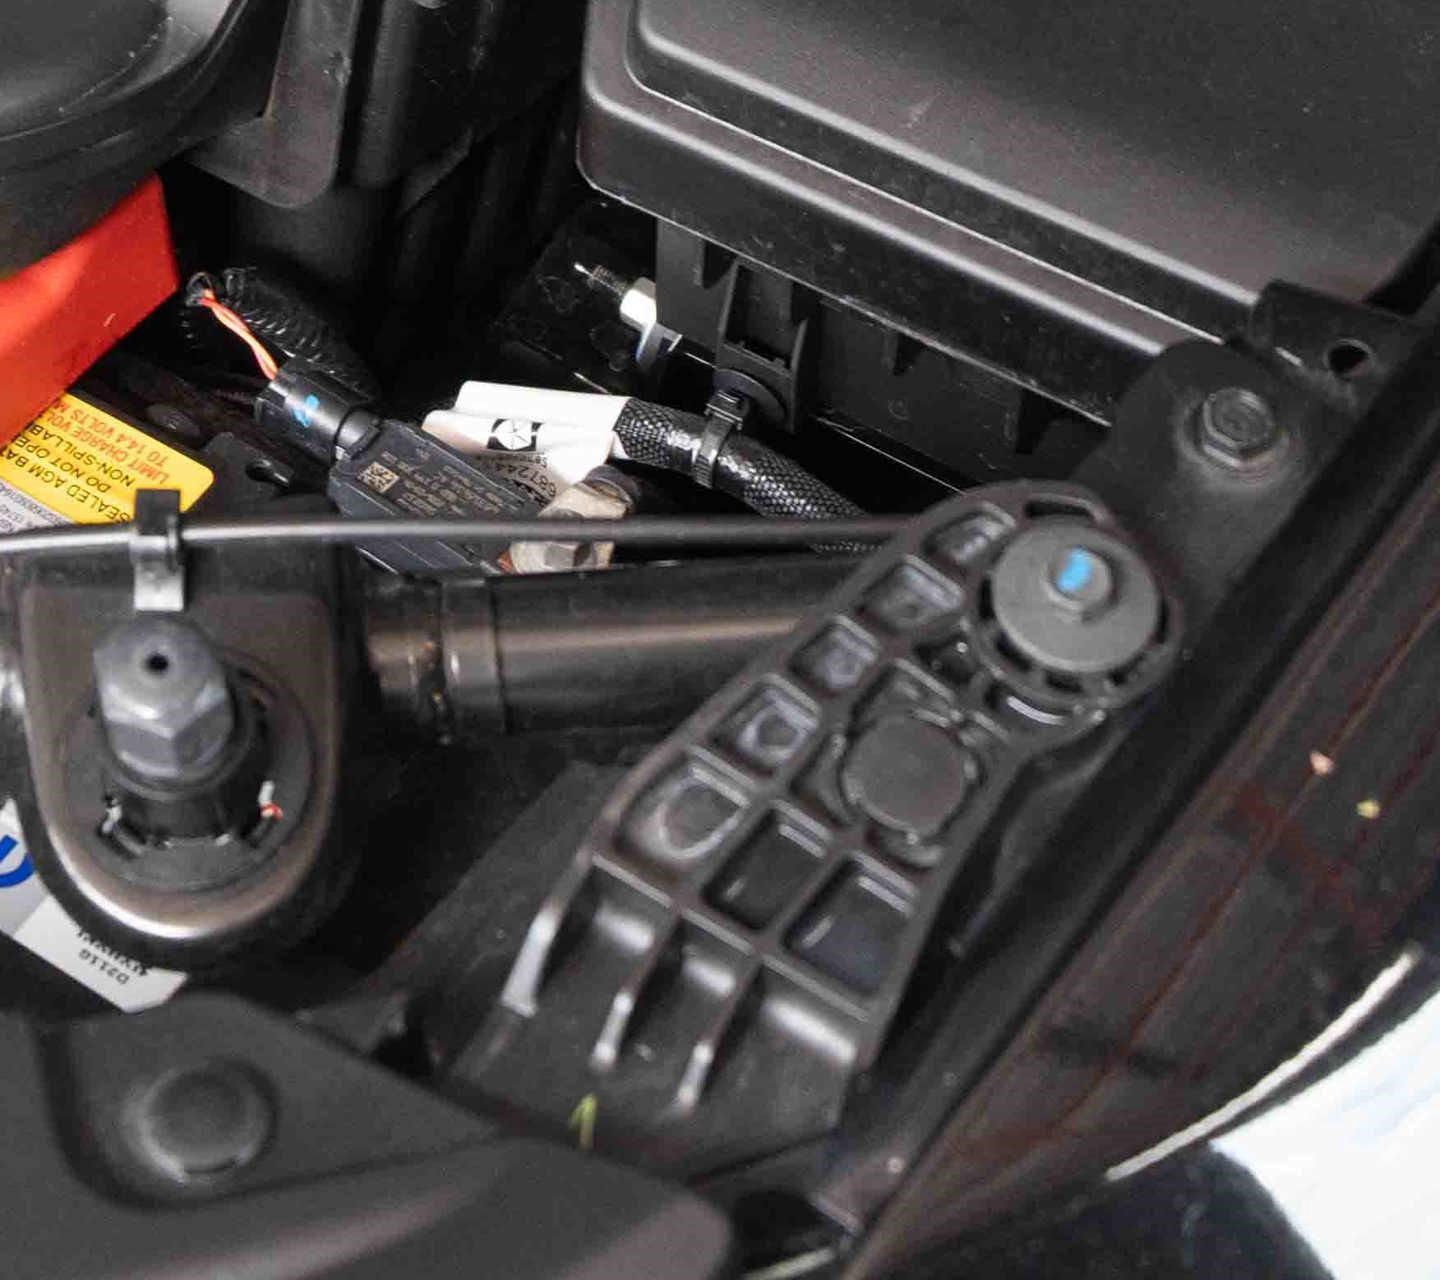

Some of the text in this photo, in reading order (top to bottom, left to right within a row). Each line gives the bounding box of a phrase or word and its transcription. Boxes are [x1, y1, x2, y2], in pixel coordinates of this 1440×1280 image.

[71, 402, 118, 434] VOLTS
[70, 426, 129, 464] CHARGE
[115, 428, 148, 454] 14.4
[50, 456, 85, 479] NOT
[126, 457, 169, 483] LIMIT
[146, 448, 168, 467] TO
[27, 462, 66, 489] AGM
[84, 474, 111, 493] DO
[65, 483, 131, 522] SEALED
